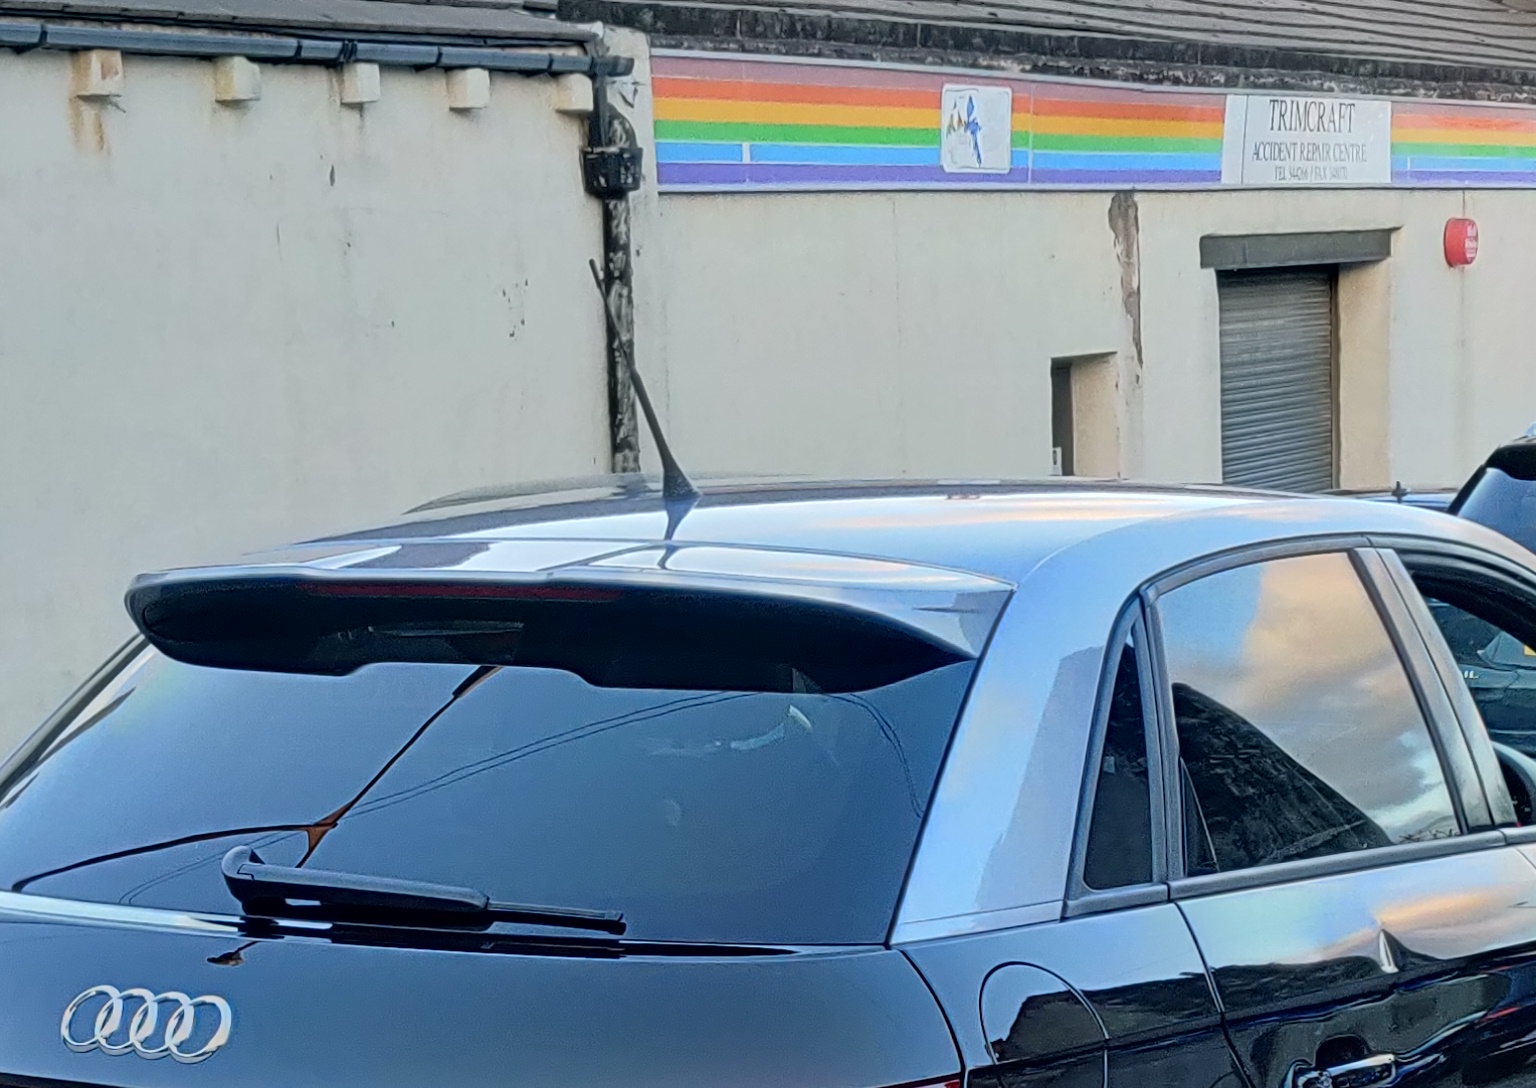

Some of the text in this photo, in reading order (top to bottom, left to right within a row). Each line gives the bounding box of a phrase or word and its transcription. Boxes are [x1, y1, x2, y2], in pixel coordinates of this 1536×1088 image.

[1269, 99, 1355, 133] TRIMCRAFT
[1252, 141, 1367, 162] ACCIDENT REPAIR CENTRE
